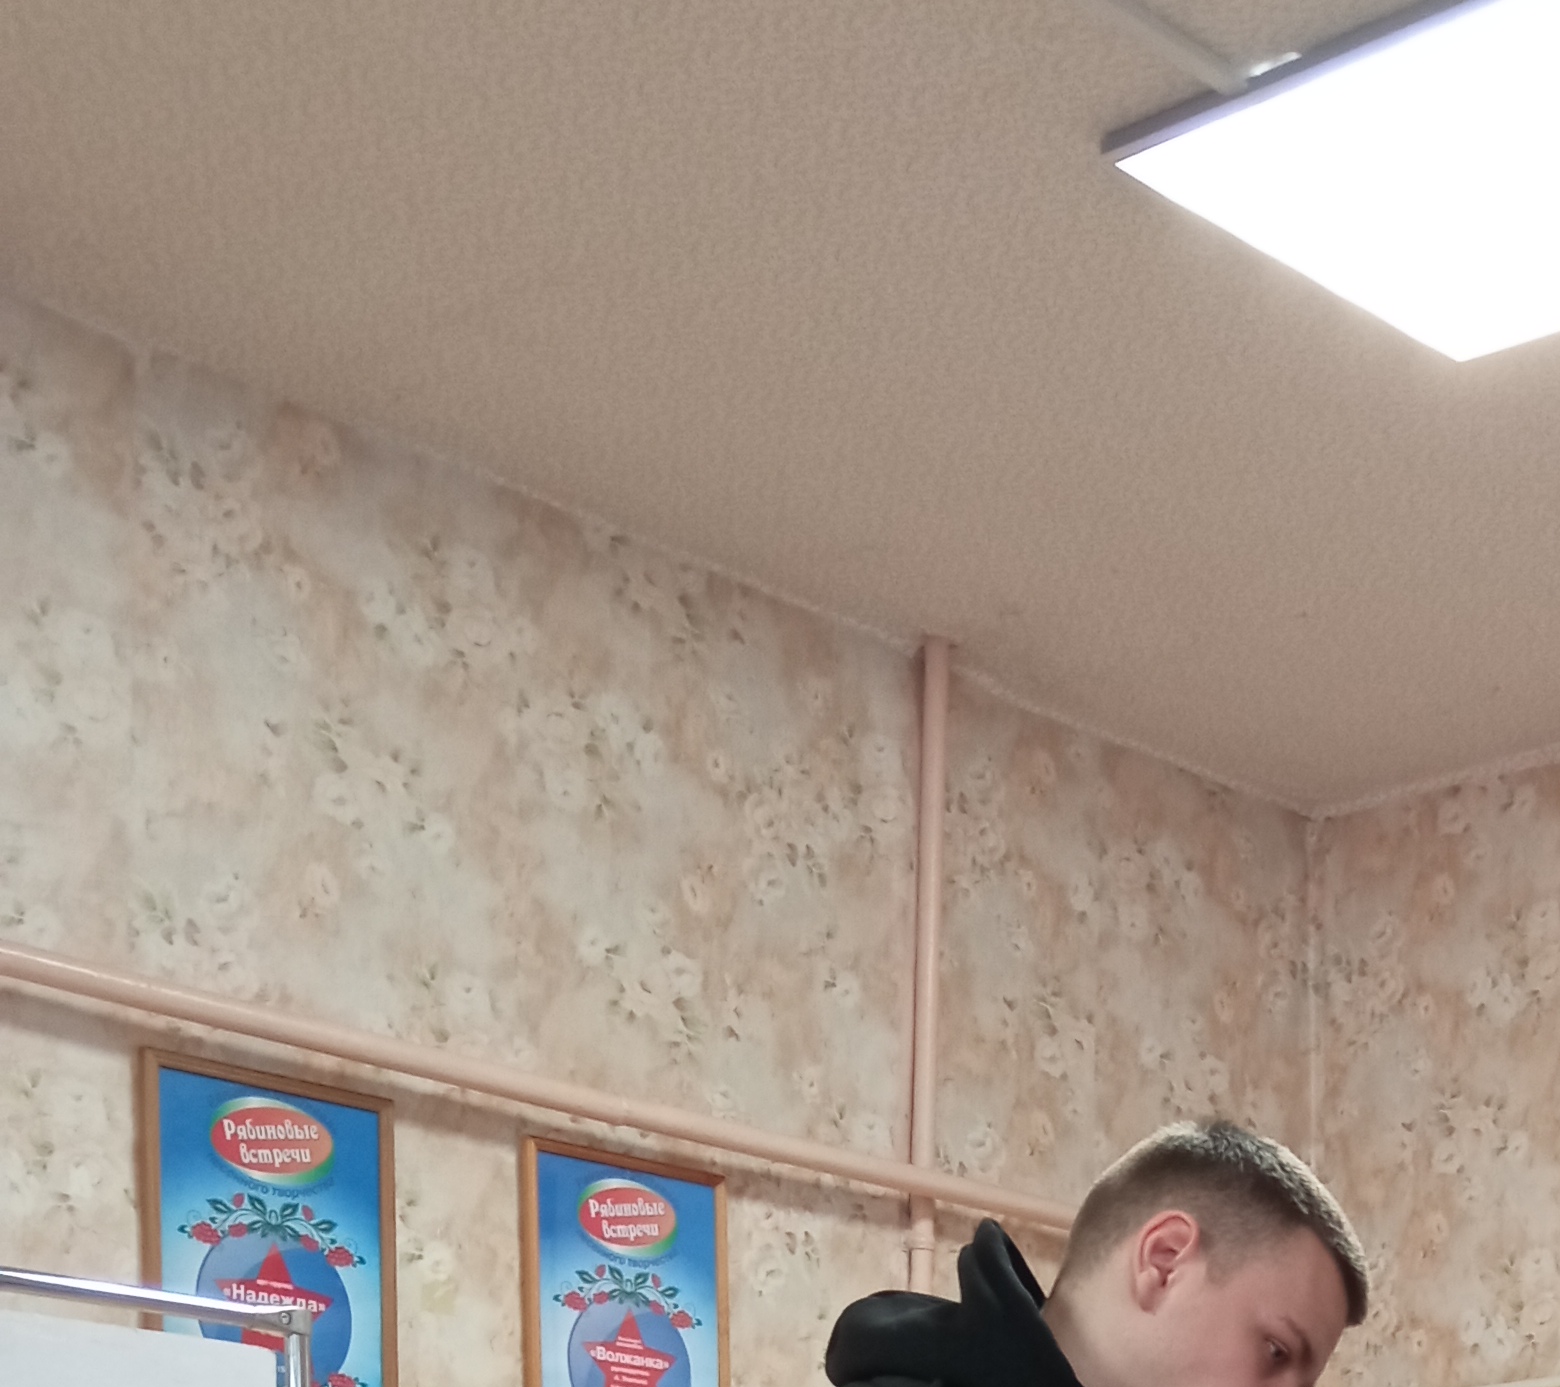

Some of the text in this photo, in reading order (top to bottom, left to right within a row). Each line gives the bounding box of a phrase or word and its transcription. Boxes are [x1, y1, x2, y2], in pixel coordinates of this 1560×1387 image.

[222, 1118, 319, 1141] Рябиновые
[239, 1142, 312, 1168] встречи
[588, 1197, 666, 1218] Рябиновые
[601, 1219, 660, 1241] встречи
[222, 1282, 326, 1312] «Надежда»
[589, 1346, 670, 1370] «Волжанка»
